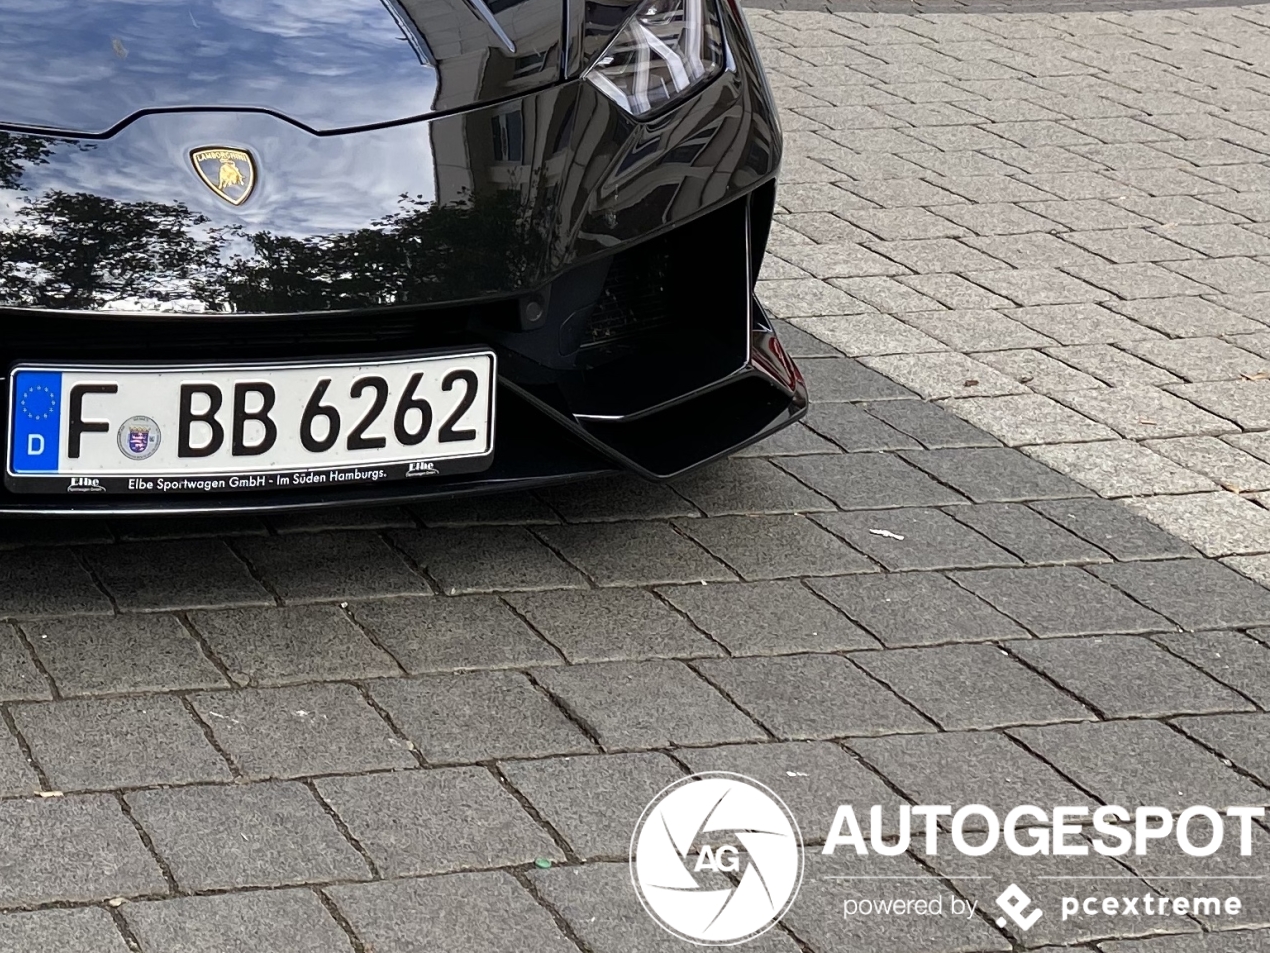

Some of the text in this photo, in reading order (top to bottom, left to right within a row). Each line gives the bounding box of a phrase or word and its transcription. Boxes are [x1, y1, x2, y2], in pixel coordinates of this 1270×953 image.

[68, 383, 119, 459] F
[177, 382, 278, 459] BB
[299, 368, 479, 453] 6262
[27, 434, 45, 455] D
[71, 477, 100, 487] Elbe
[128, 478, 153, 490] Elbe
[156, 478, 225, 492] Sportwagen
[229, 475, 265, 489] GmbH
[276, 475, 289, 486] Im
[292, 471, 326, 485] Süden
[329, 468, 387, 483] Hamburgs.
